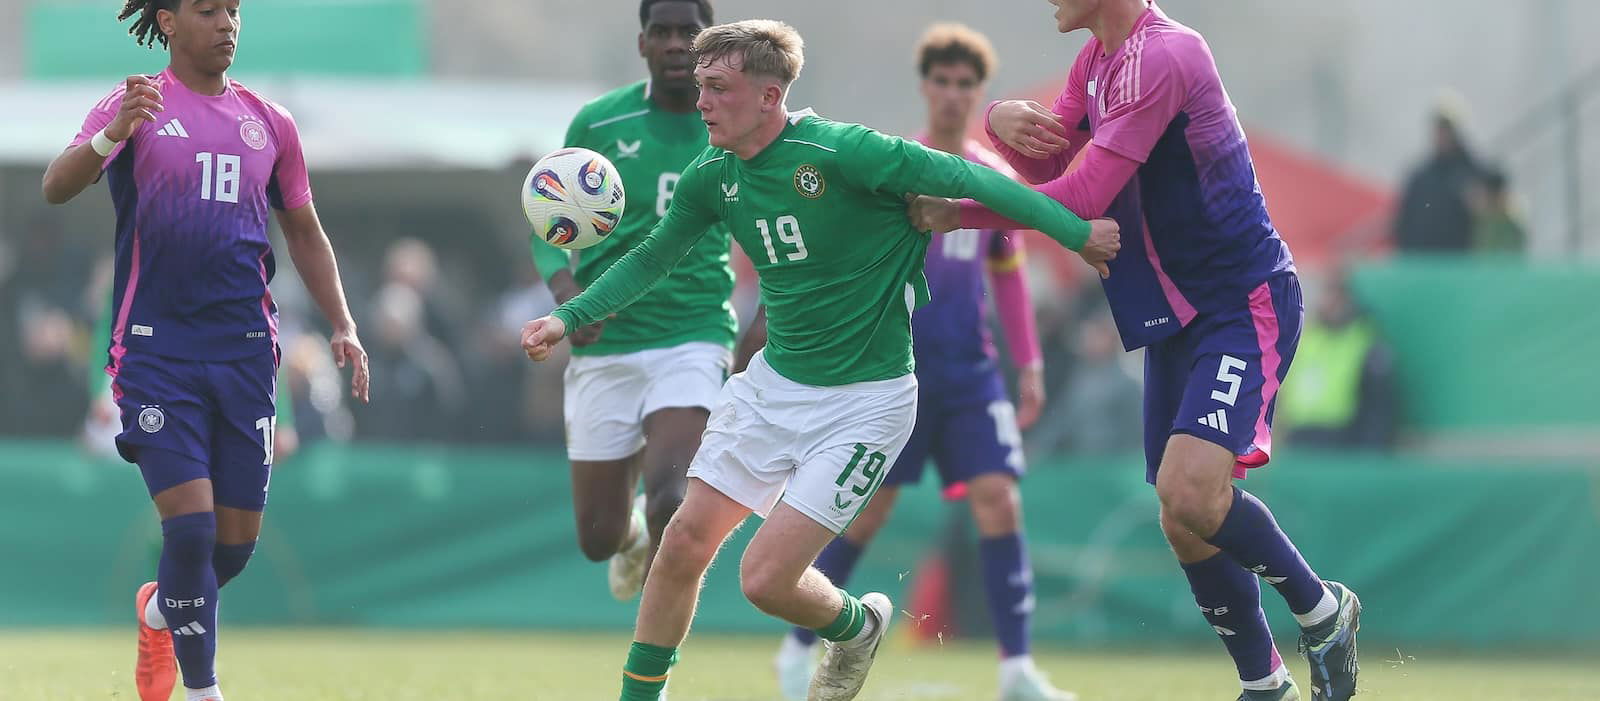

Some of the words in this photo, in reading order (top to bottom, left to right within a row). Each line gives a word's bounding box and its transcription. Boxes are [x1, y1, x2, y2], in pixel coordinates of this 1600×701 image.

[195, 152, 241, 203] 18
[656, 172, 681, 217] 8
[756, 215, 808, 264] 19
[1210, 354, 1247, 407] 5
[255, 415, 277, 465] 1
[987, 401, 1022, 447] 1
[835, 442, 887, 497] 19
[164, 596, 206, 609] DFB
[1199, 605, 1230, 616] FB
